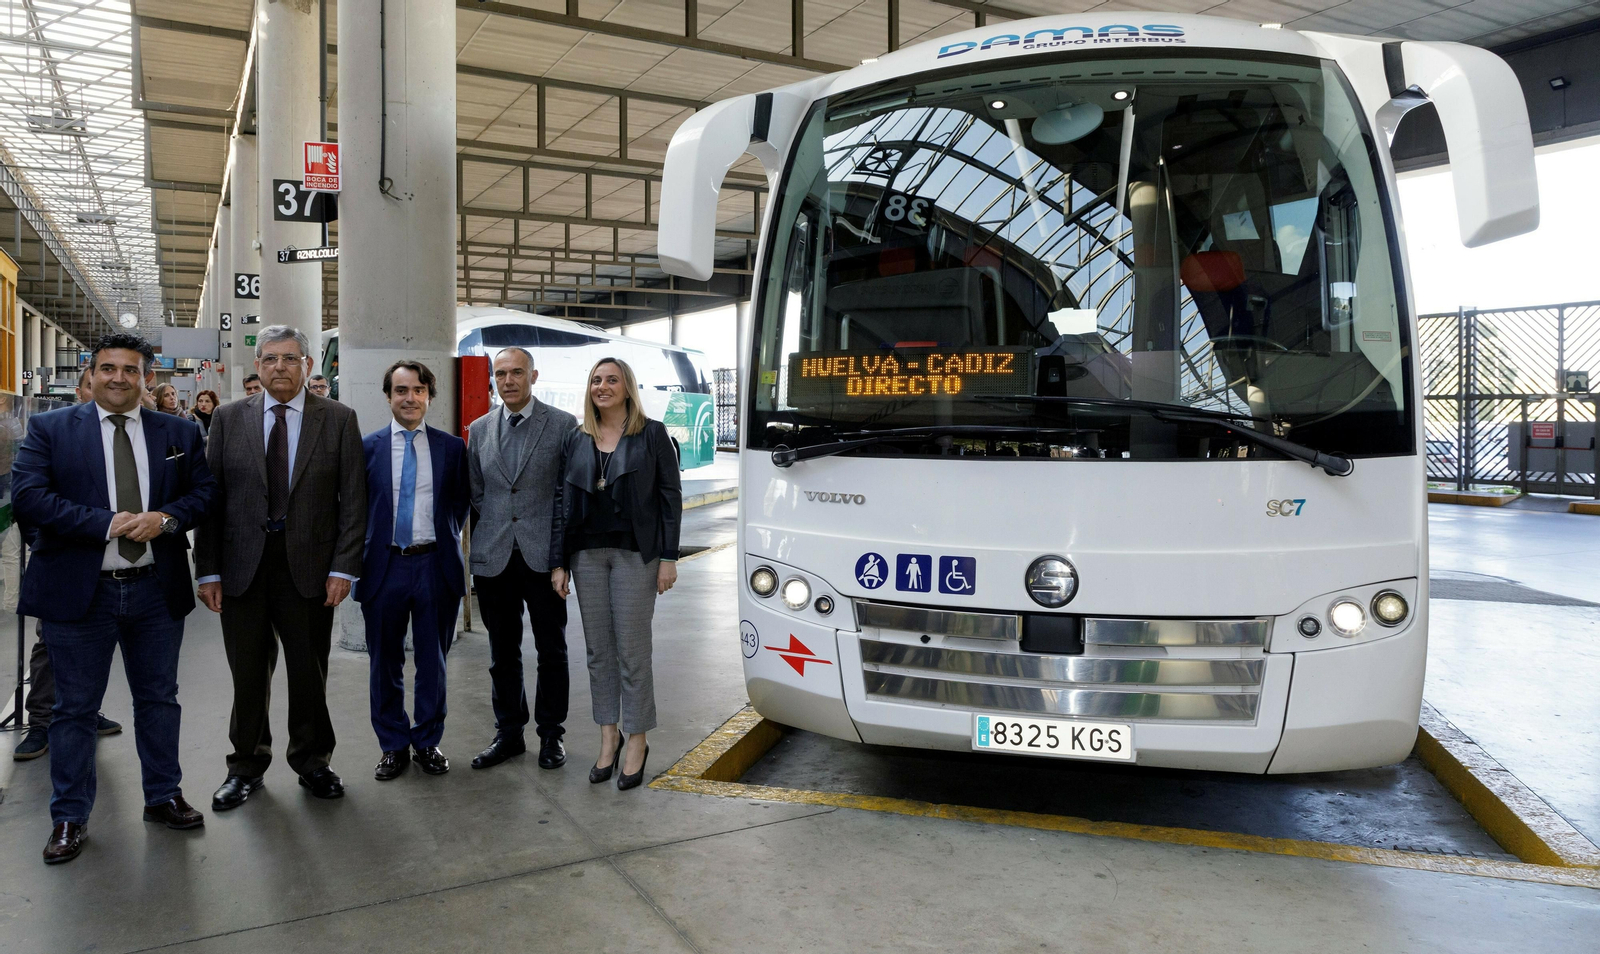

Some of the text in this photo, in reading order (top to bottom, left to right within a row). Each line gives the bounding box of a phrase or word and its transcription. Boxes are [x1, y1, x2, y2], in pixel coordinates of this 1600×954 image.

[937, 24, 1186, 59] DAMAS
[1023, 39, 1087, 50] GRUPO
[278, 182, 318, 216] 37
[279, 251, 290, 262] 37
[236, 275, 260, 297] 36
[23, 371, 33, 379] 13
[801, 355, 899, 378] HUELVA
[927, 353, 1014, 374] CADIZ
[846, 375, 961, 396] DIRECTO
[803, 490, 867, 506] VOLVO
[1265, 498, 1307, 518] SC7
[980, 721, 1122, 753] E 8325 KGS
